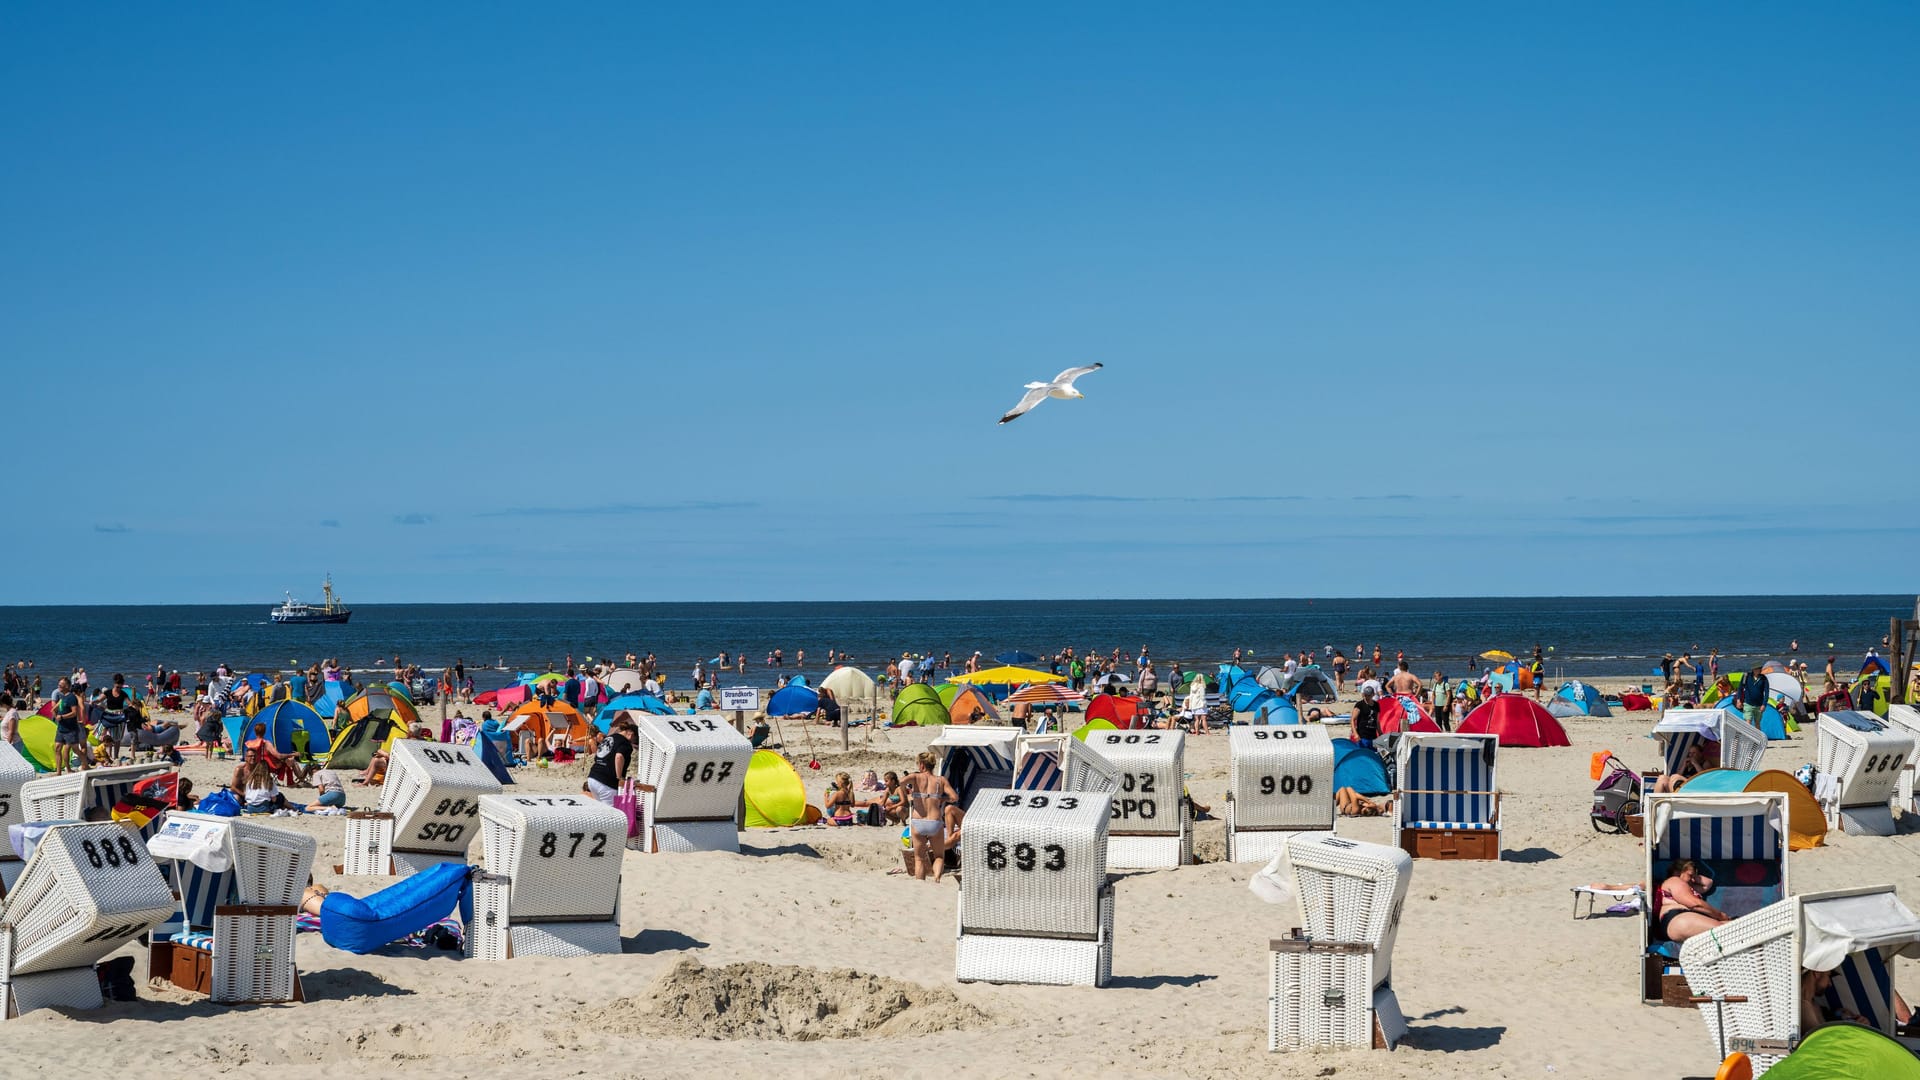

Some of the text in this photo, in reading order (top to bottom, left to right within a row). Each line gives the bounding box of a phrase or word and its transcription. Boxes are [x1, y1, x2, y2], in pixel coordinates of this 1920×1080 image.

[1106, 734, 1161, 744] 902
[1254, 730, 1307, 740] 900
[423, 748, 471, 766] 904
[682, 761, 735, 784] 867
[1121, 772, 1155, 793] 02
[1260, 774, 1313, 795] 900
[434, 798, 479, 818] 904
[1001, 794, 1079, 810] 893
[1110, 798, 1156, 819] SPO
[418, 822, 465, 843] SPO
[82, 836, 138, 869] 888
[539, 831, 608, 858] 872
[986, 840, 1067, 872] 893
[1731, 1038, 1756, 1052] 894
